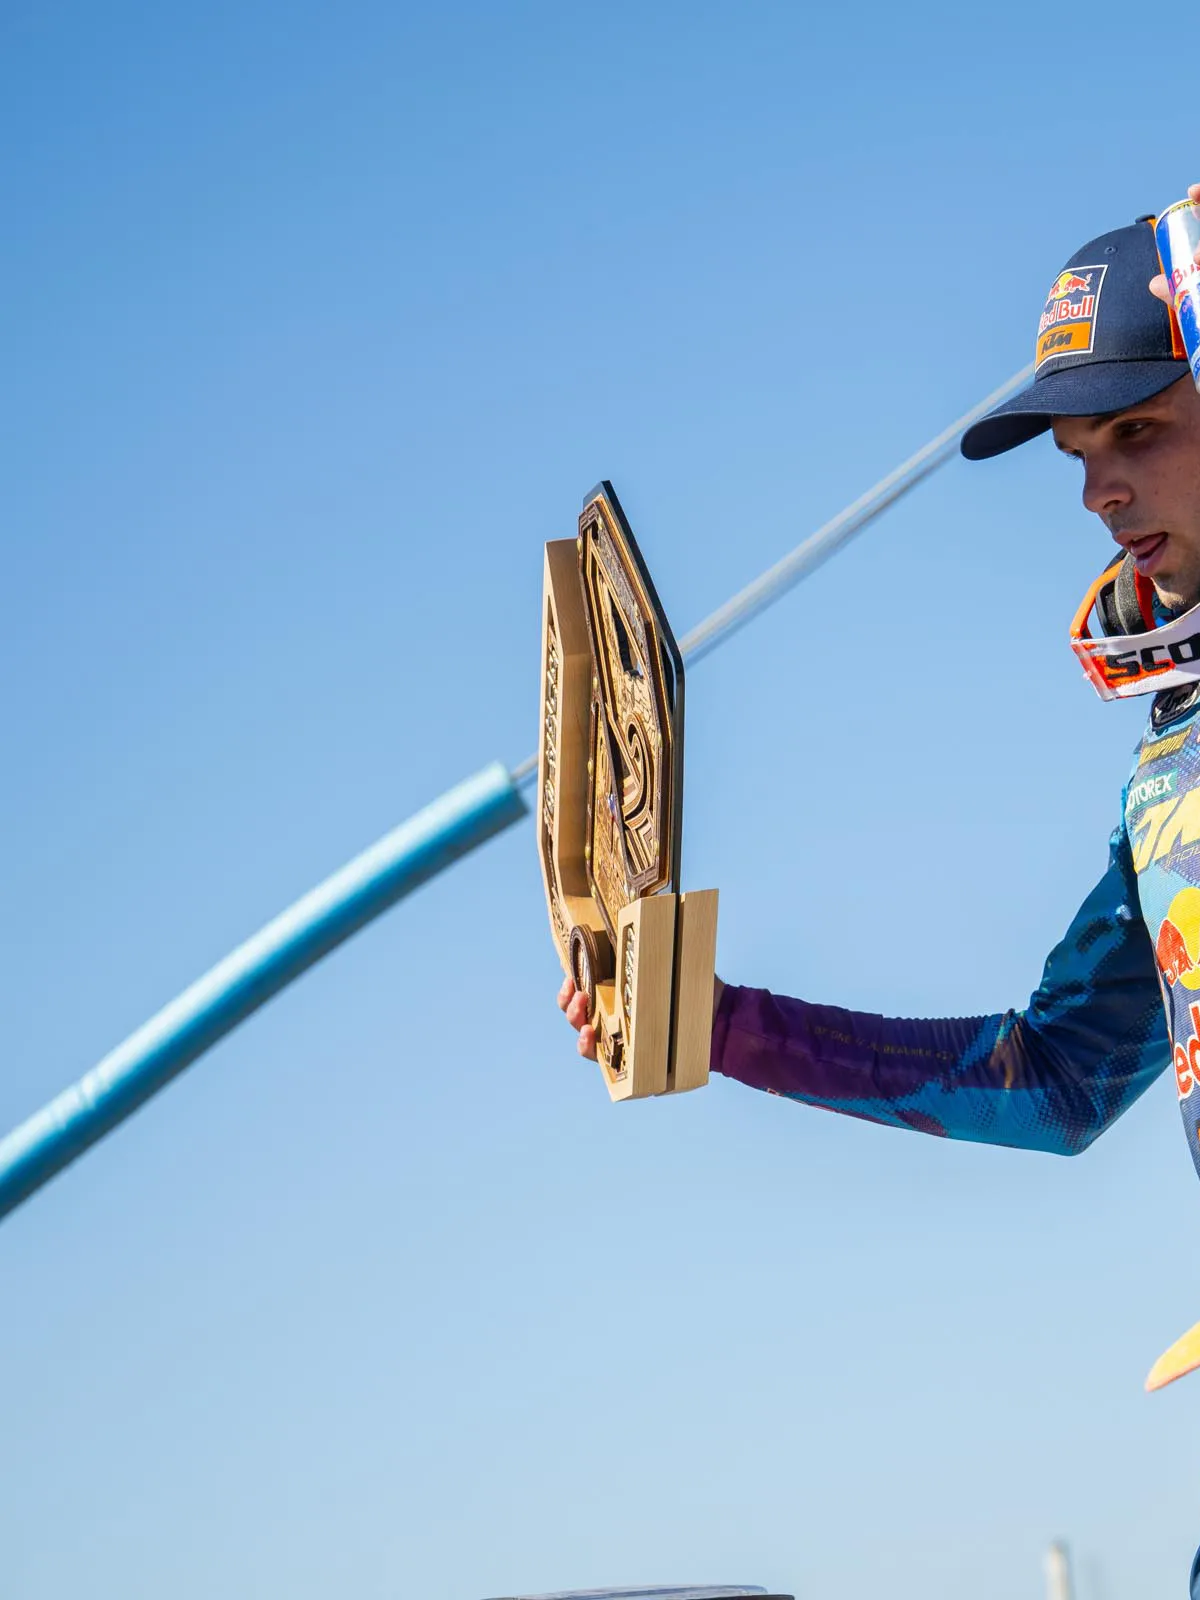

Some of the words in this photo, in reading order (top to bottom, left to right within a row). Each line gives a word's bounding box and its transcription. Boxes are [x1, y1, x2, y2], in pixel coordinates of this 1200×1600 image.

[1057, 295, 1095, 321] Bull
[1041, 330, 1073, 355] KTM
[1125, 772, 1173, 816] OTOREX
